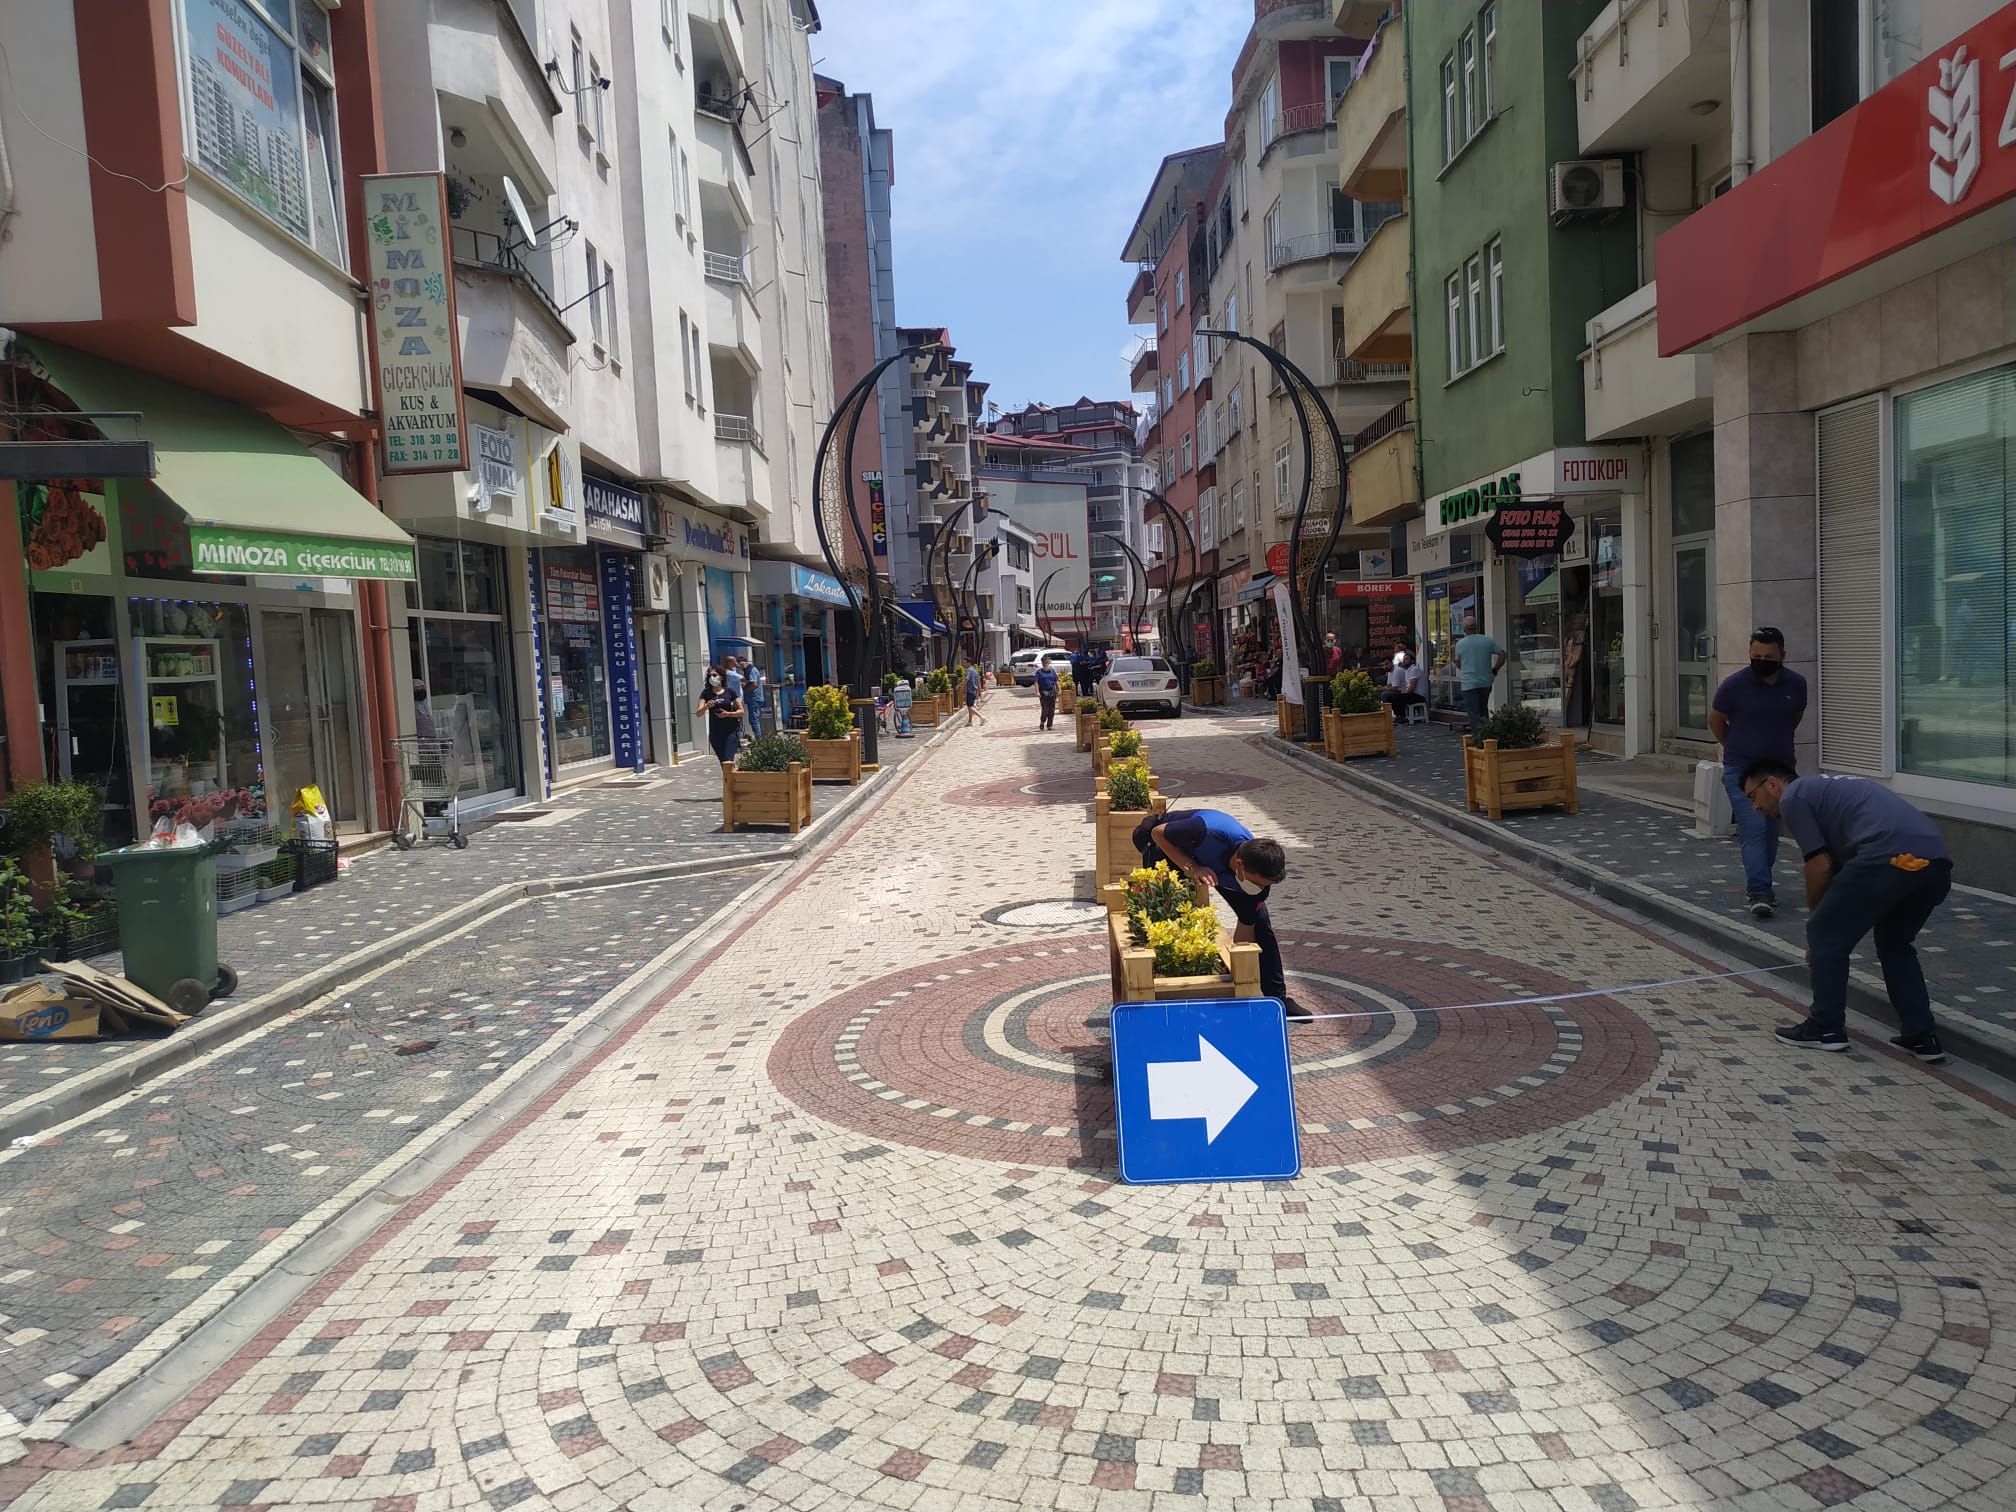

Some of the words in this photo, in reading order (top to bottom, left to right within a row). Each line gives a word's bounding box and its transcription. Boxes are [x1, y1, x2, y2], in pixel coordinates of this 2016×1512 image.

[383, 362, 453, 392] ÇİÇEKÇİLİK
[400, 395, 425, 412] KUŞ
[430, 394, 440, 410] &
[387, 413, 457, 431] AKVARYUM
[388, 435, 405, 447] TEL:
[410, 434, 425, 446] 318
[430, 434, 441, 445] 30
[446, 433, 457, 444] 90
[480, 431, 512, 462] FOTO
[389, 451, 408, 462] FAX:
[412, 450, 428, 461] 314
[433, 449, 442, 460] 17
[448, 448, 459, 460] 28
[1439, 488, 1480, 526] FOTO
[1499, 510, 1531, 526] FOTO
[1532, 510, 1562, 527] FLAŞ
[198, 538, 288, 567] MİMOZA
[1032, 532, 1078, 559] GÜL
[606, 557, 618, 583] CEP
[1357, 583, 1392, 593] BÖREK
[17, 1010, 65, 1035] Teno
